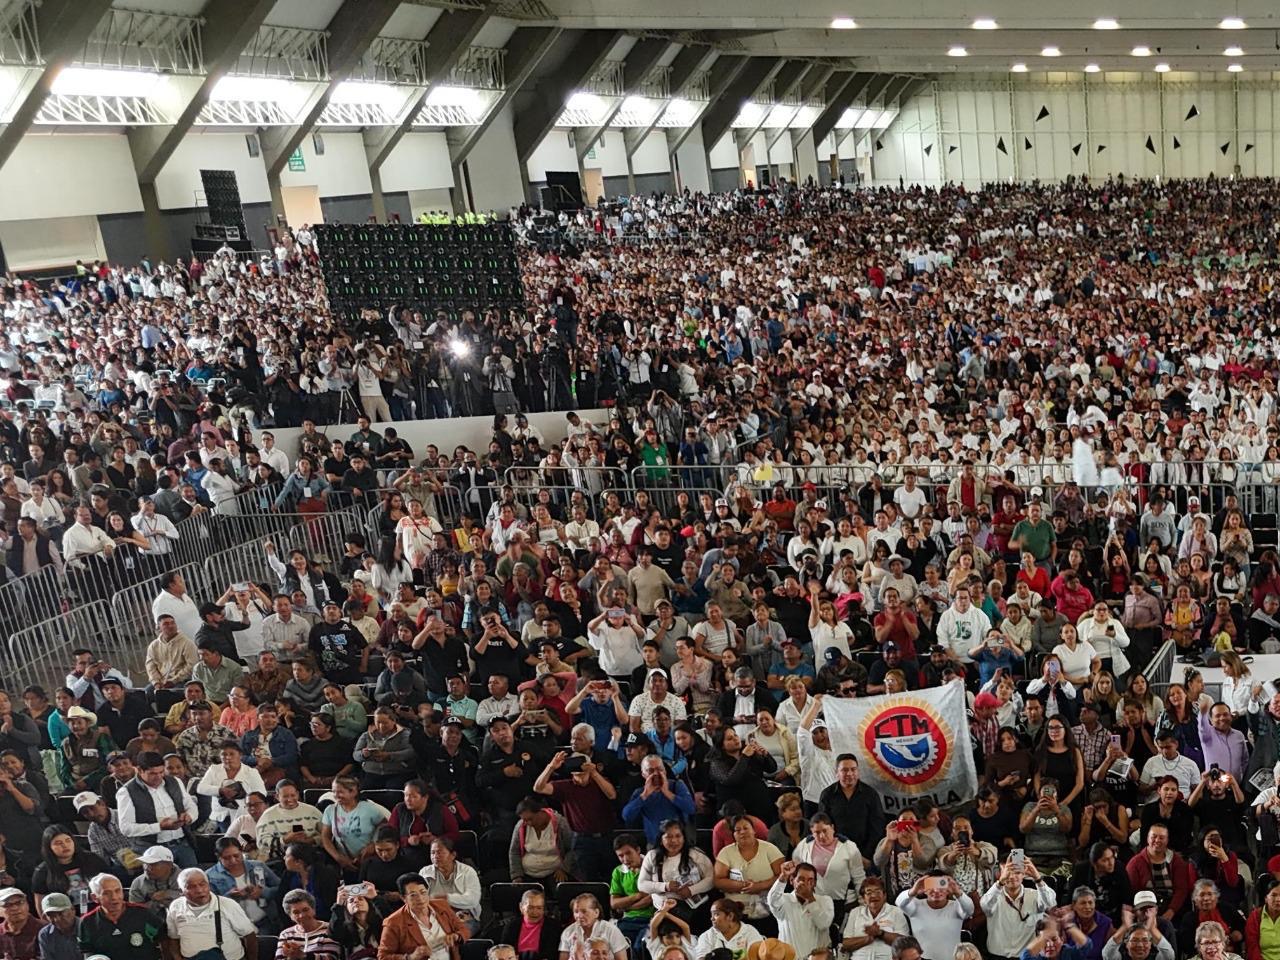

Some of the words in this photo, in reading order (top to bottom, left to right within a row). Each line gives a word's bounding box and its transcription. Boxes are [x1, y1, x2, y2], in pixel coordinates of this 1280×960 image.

[874, 714, 929, 739] CTM
[883, 790, 962, 810] PUELA
[1035, 815, 1058, 825] 1989
